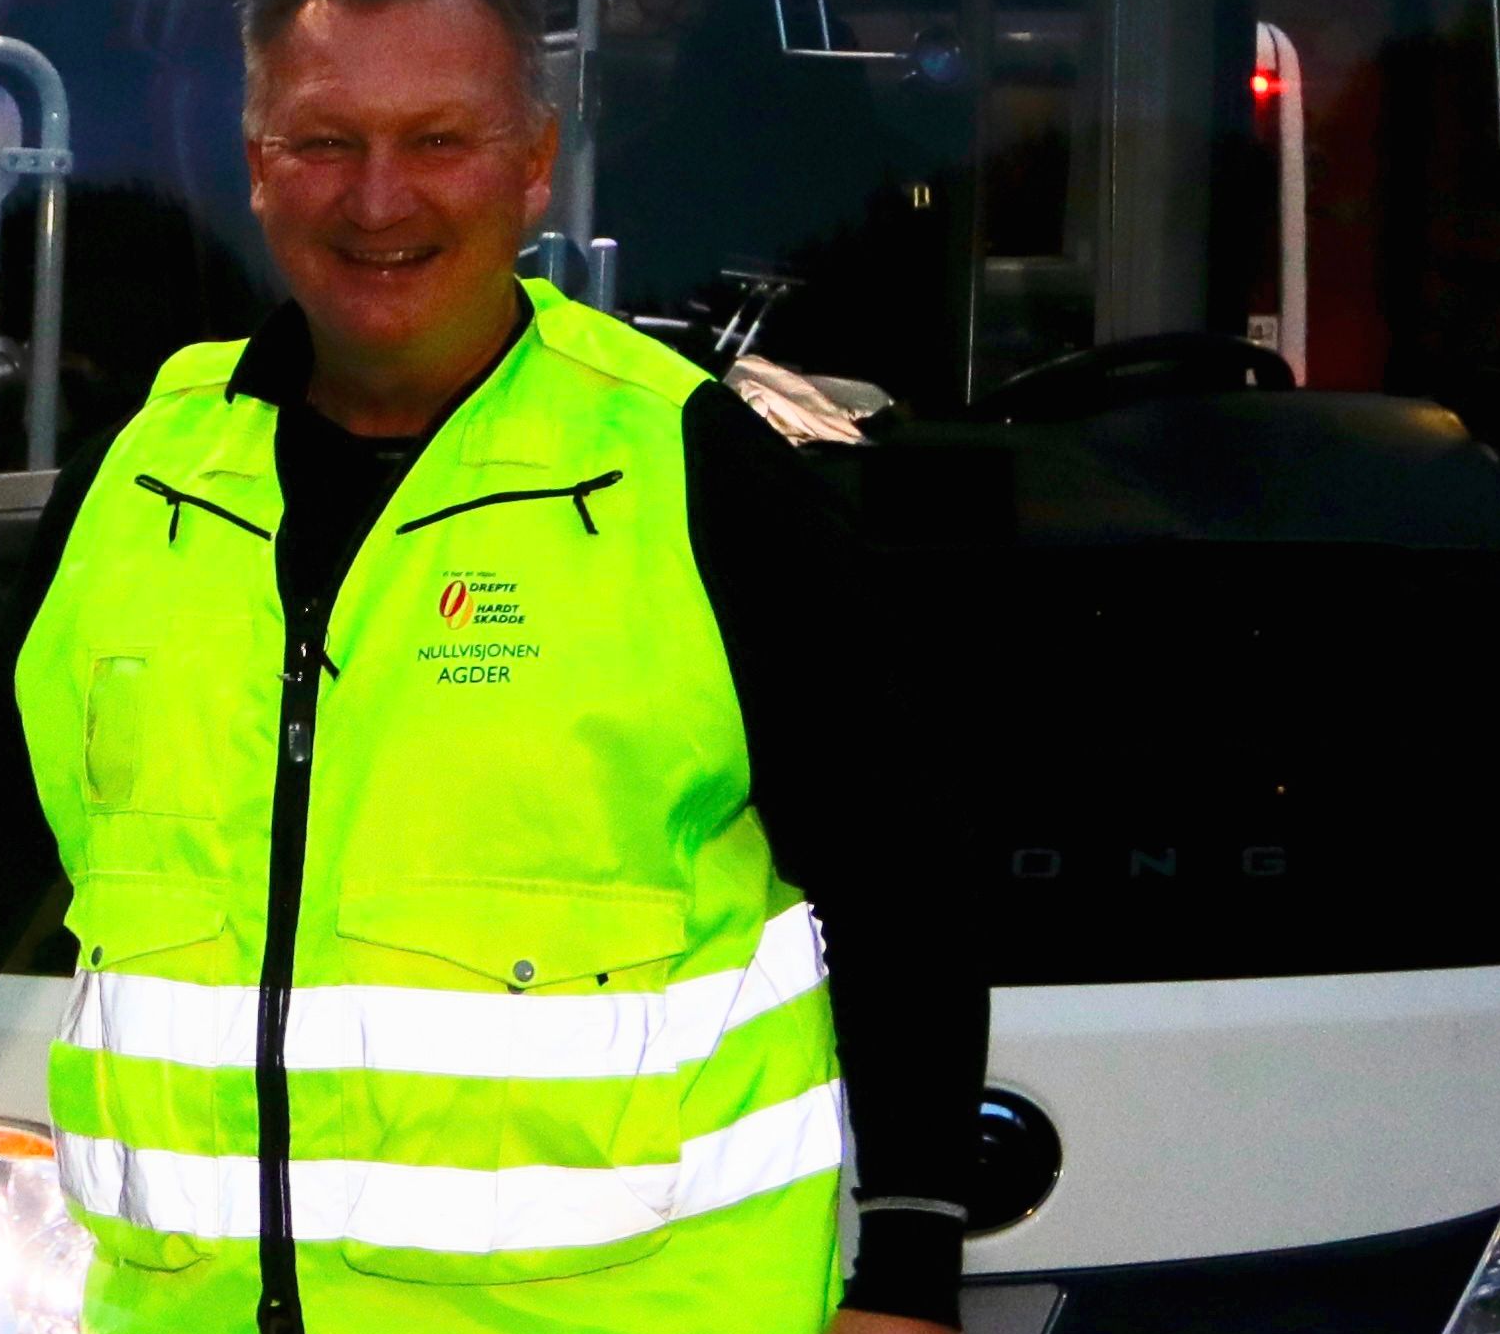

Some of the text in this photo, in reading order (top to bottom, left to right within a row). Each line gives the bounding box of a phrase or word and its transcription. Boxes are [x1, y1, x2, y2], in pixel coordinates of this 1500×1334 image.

[469, 582, 518, 593] DREPTE
[476, 603, 520, 614] HARDT
[473, 614, 526, 625] SKADDE
[417, 643, 540, 662] NULLVISJONEN
[437, 665, 511, 685] AGDER
[1011, 846, 1288, 878] ONG
